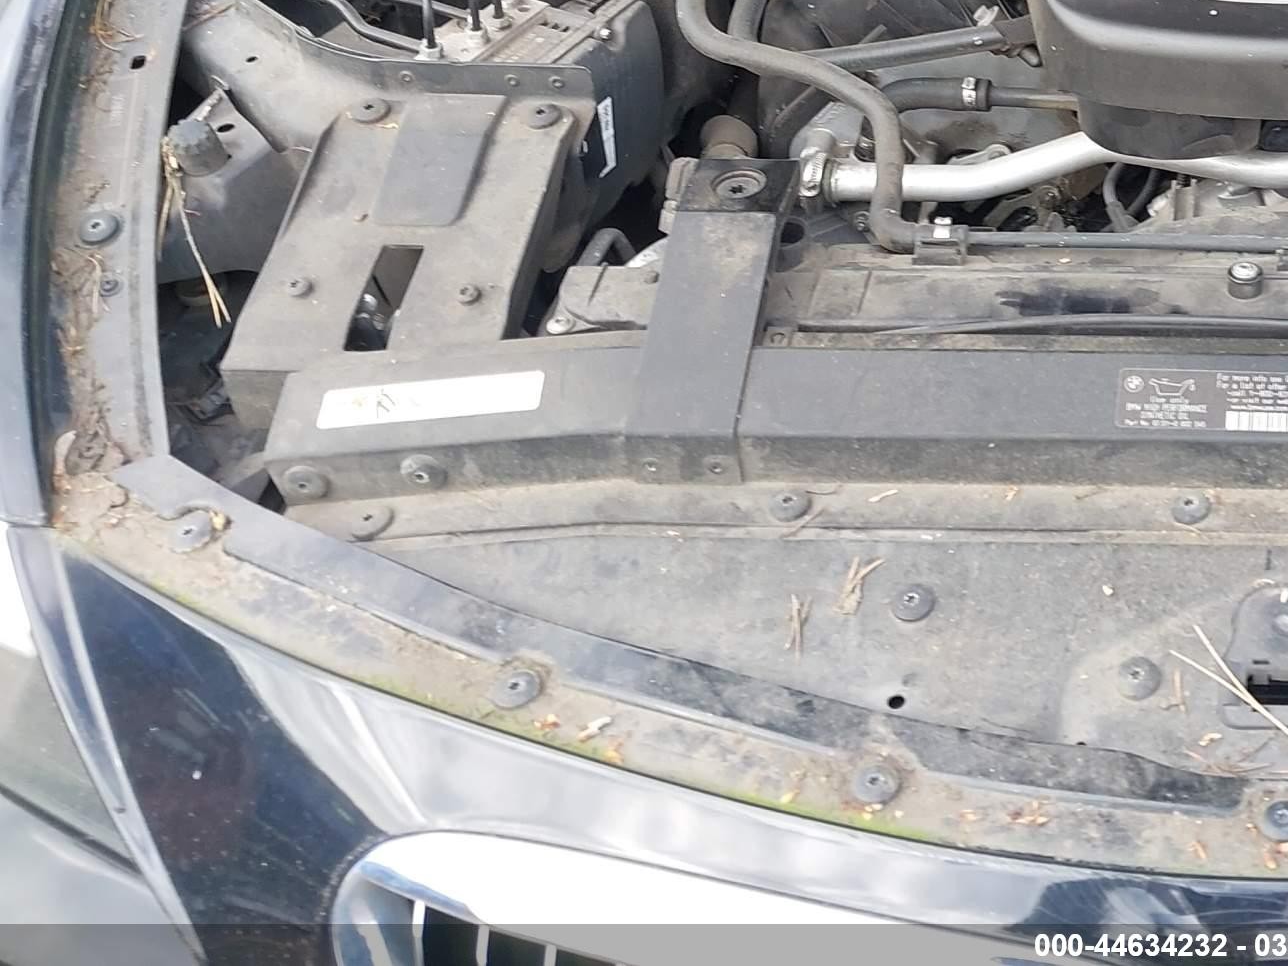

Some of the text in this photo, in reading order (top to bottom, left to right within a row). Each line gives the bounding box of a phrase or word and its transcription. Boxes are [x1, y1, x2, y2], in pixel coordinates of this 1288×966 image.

[1217, 373, 1230, 381] For
[1216, 380, 1230, 389] For
[1240, 382, 1254, 390] list
[1256, 382, 1266, 390] of
[1125, 402, 1209, 413] BMW HIGH PERFORMANCE
[1140, 411, 1176, 420] SYNTHETIC
